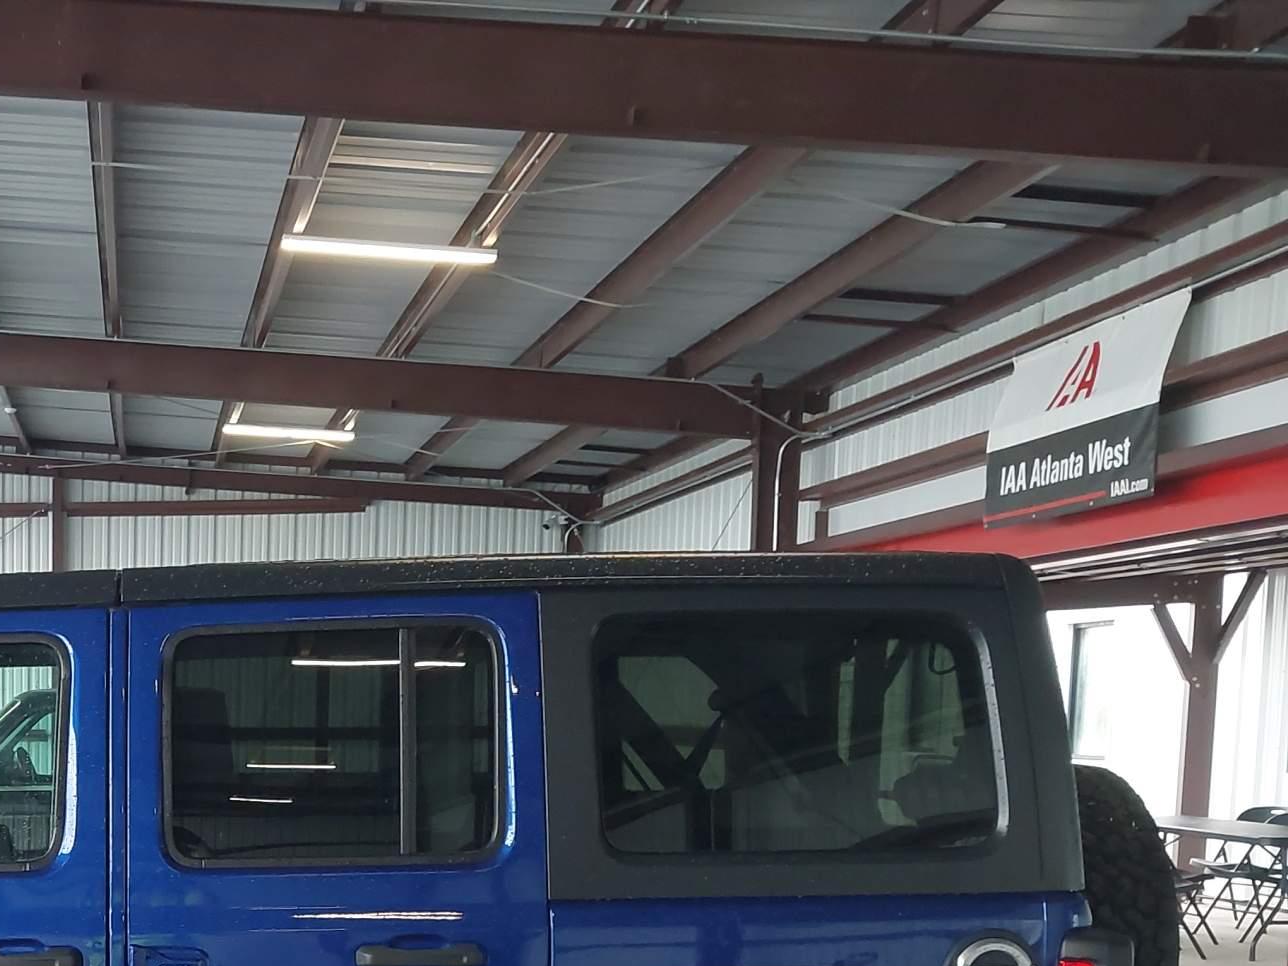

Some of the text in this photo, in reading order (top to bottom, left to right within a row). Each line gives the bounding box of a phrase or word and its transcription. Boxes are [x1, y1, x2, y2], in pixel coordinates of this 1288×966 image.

[1000, 436, 1131, 496] IAA Atlanta West
